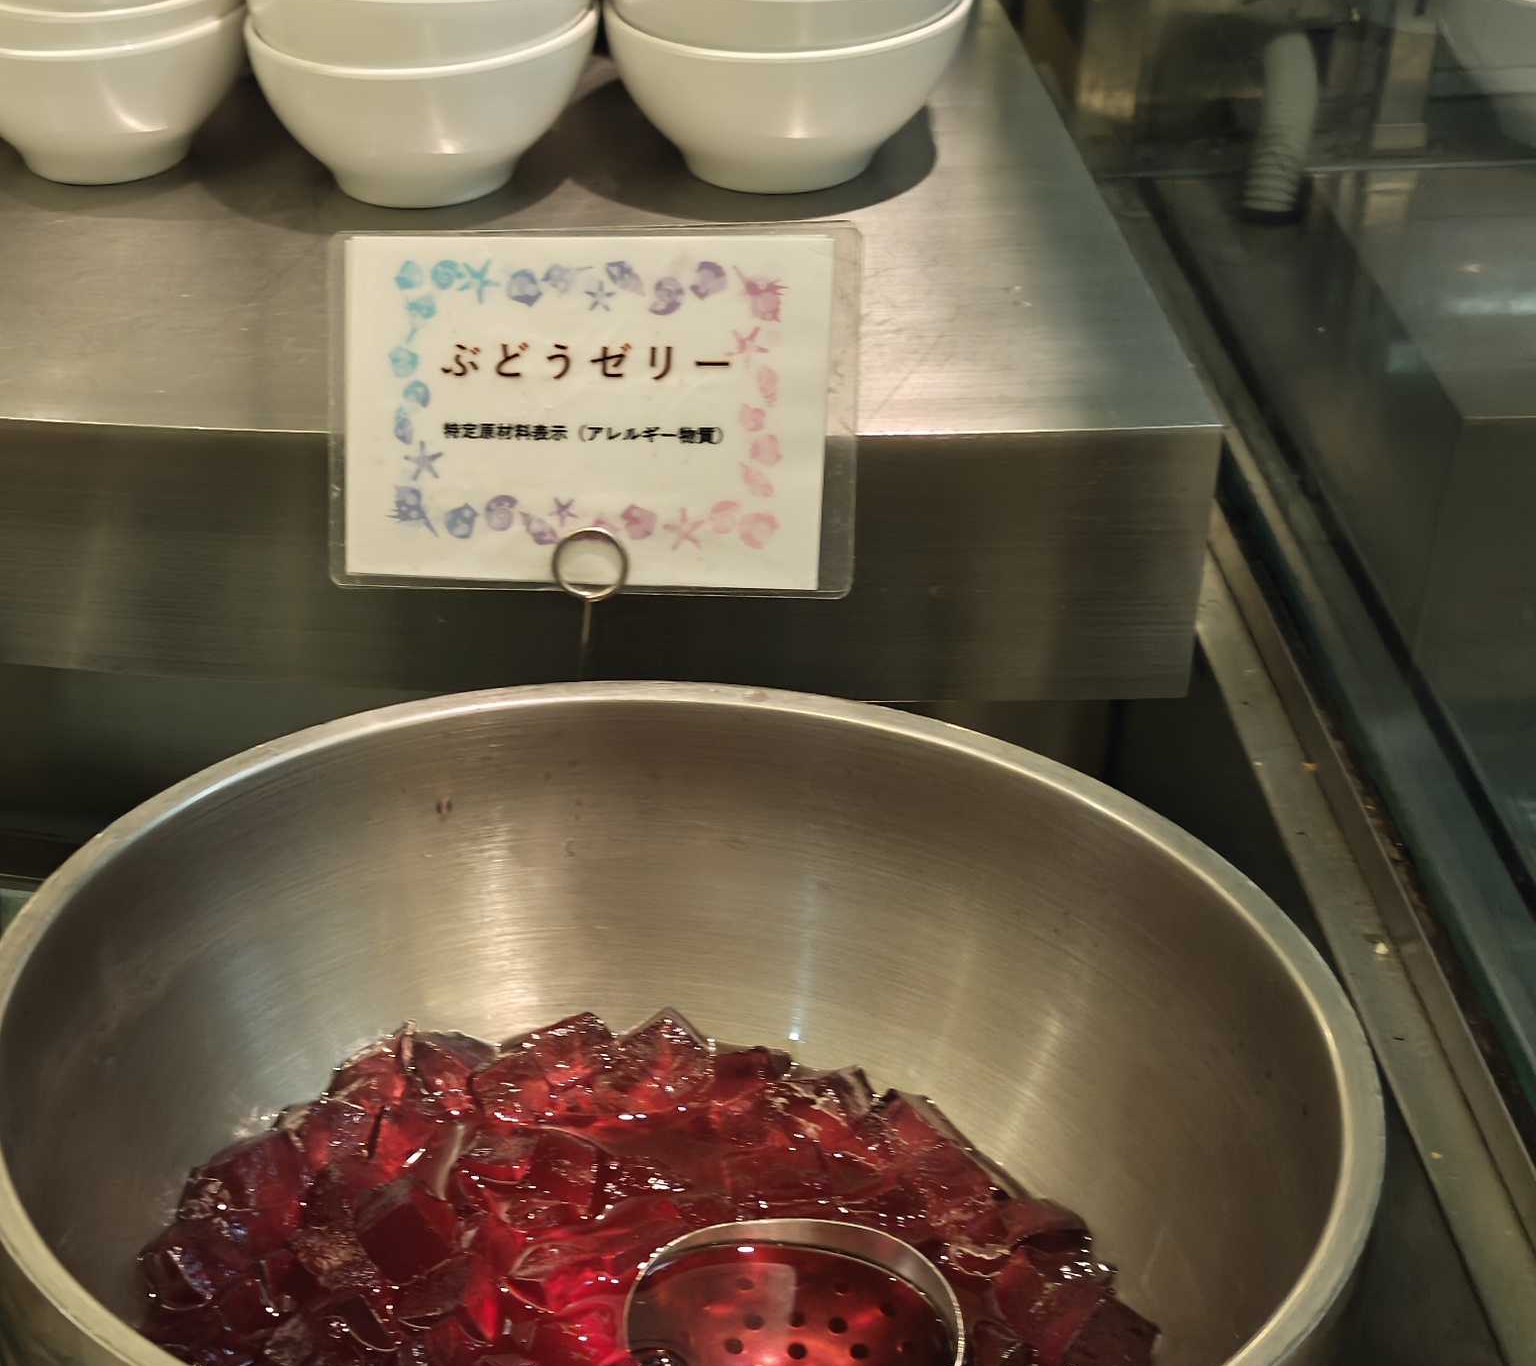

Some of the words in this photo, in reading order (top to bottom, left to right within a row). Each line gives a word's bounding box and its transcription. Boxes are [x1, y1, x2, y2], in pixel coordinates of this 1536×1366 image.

[440, 342, 732, 380] ぶどうゼリー
